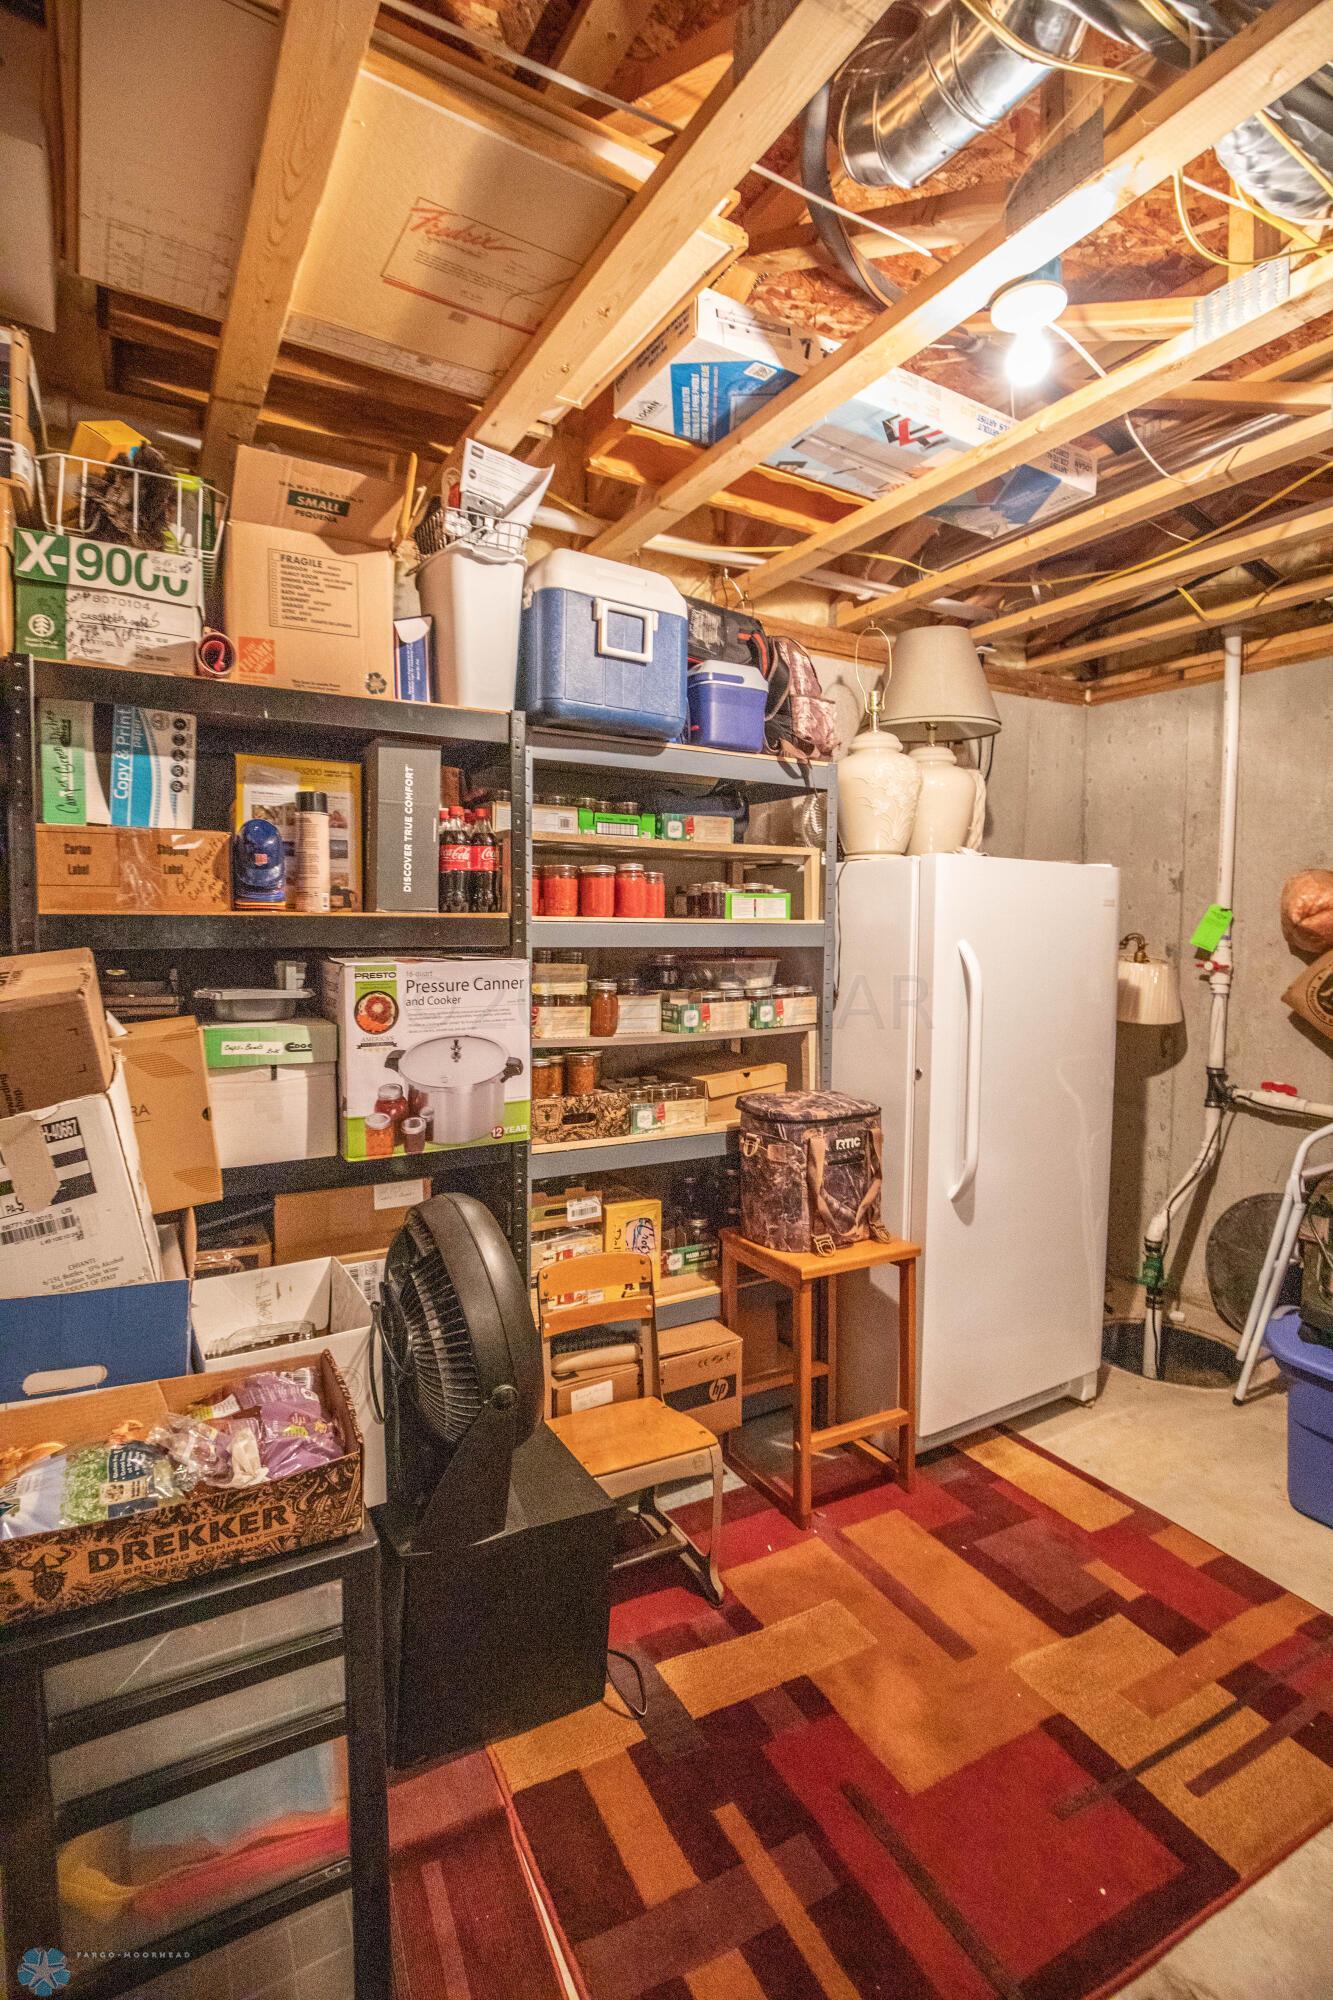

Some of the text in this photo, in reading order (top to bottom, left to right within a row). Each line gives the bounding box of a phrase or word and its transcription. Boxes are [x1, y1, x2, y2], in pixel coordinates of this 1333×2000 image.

[296, 495, 341, 515] SMALL
[280, 554, 323, 568] FRAGILE
[116, 708, 132, 746] Print
[113, 765, 132, 799] Copy
[403, 765, 415, 893] DISCOVER TRUE COMFORT
[67, 863, 90, 876] Label
[354, 971, 397, 979] PRESTO
[406, 977, 525, 994] Pressure Canner
[406, 996, 461, 1006] and Cooker
[504, 1125, 528, 1134] YEAR
[835, 1137, 861, 1151] RTIC
[88, 1504, 290, 1574] DREKKER
[123, 1533, 264, 1576] BREWING COMPANY
